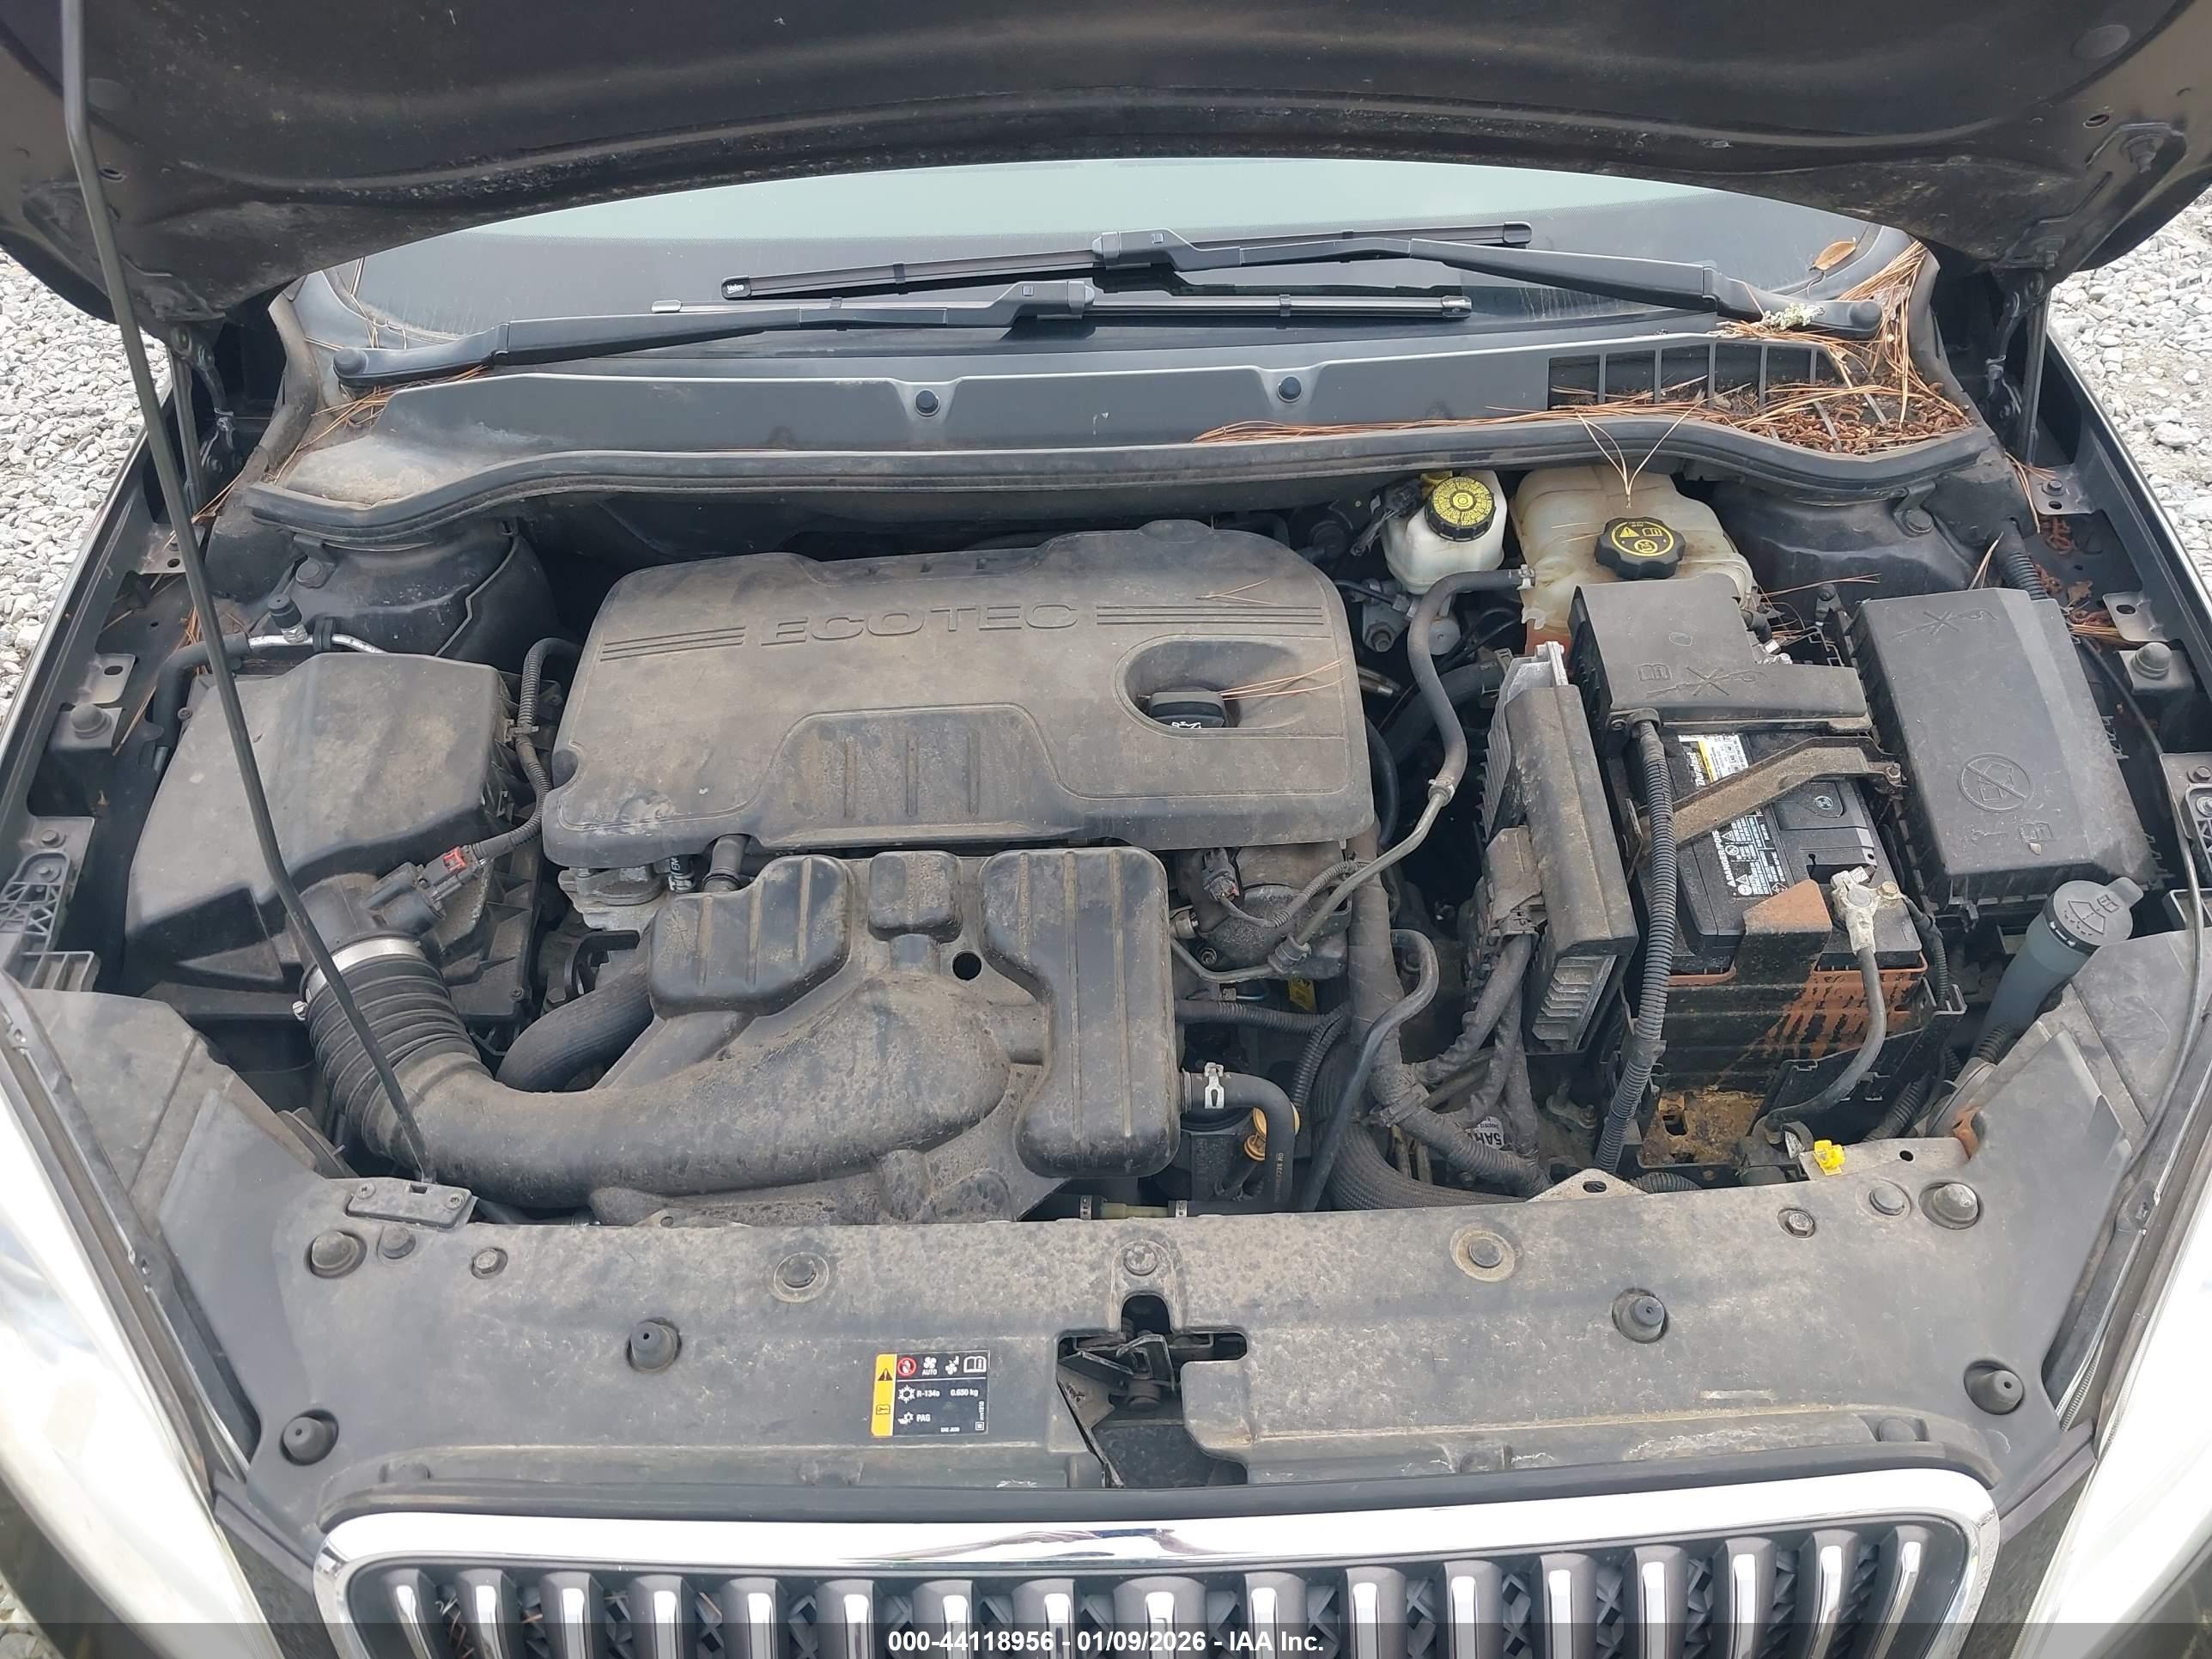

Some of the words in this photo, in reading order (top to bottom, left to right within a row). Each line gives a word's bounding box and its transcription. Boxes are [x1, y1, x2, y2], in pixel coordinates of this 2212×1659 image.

[761, 603, 1078, 646] ECOTEC
[1686, 751, 1705, 787] Duralast
[1711, 830, 1735, 881] DANGER/POIS
[916, 1389, 940, 1398] R-134a
[969, 1388, 979, 1397] kg
[916, 1413, 931, 1423] PAG
